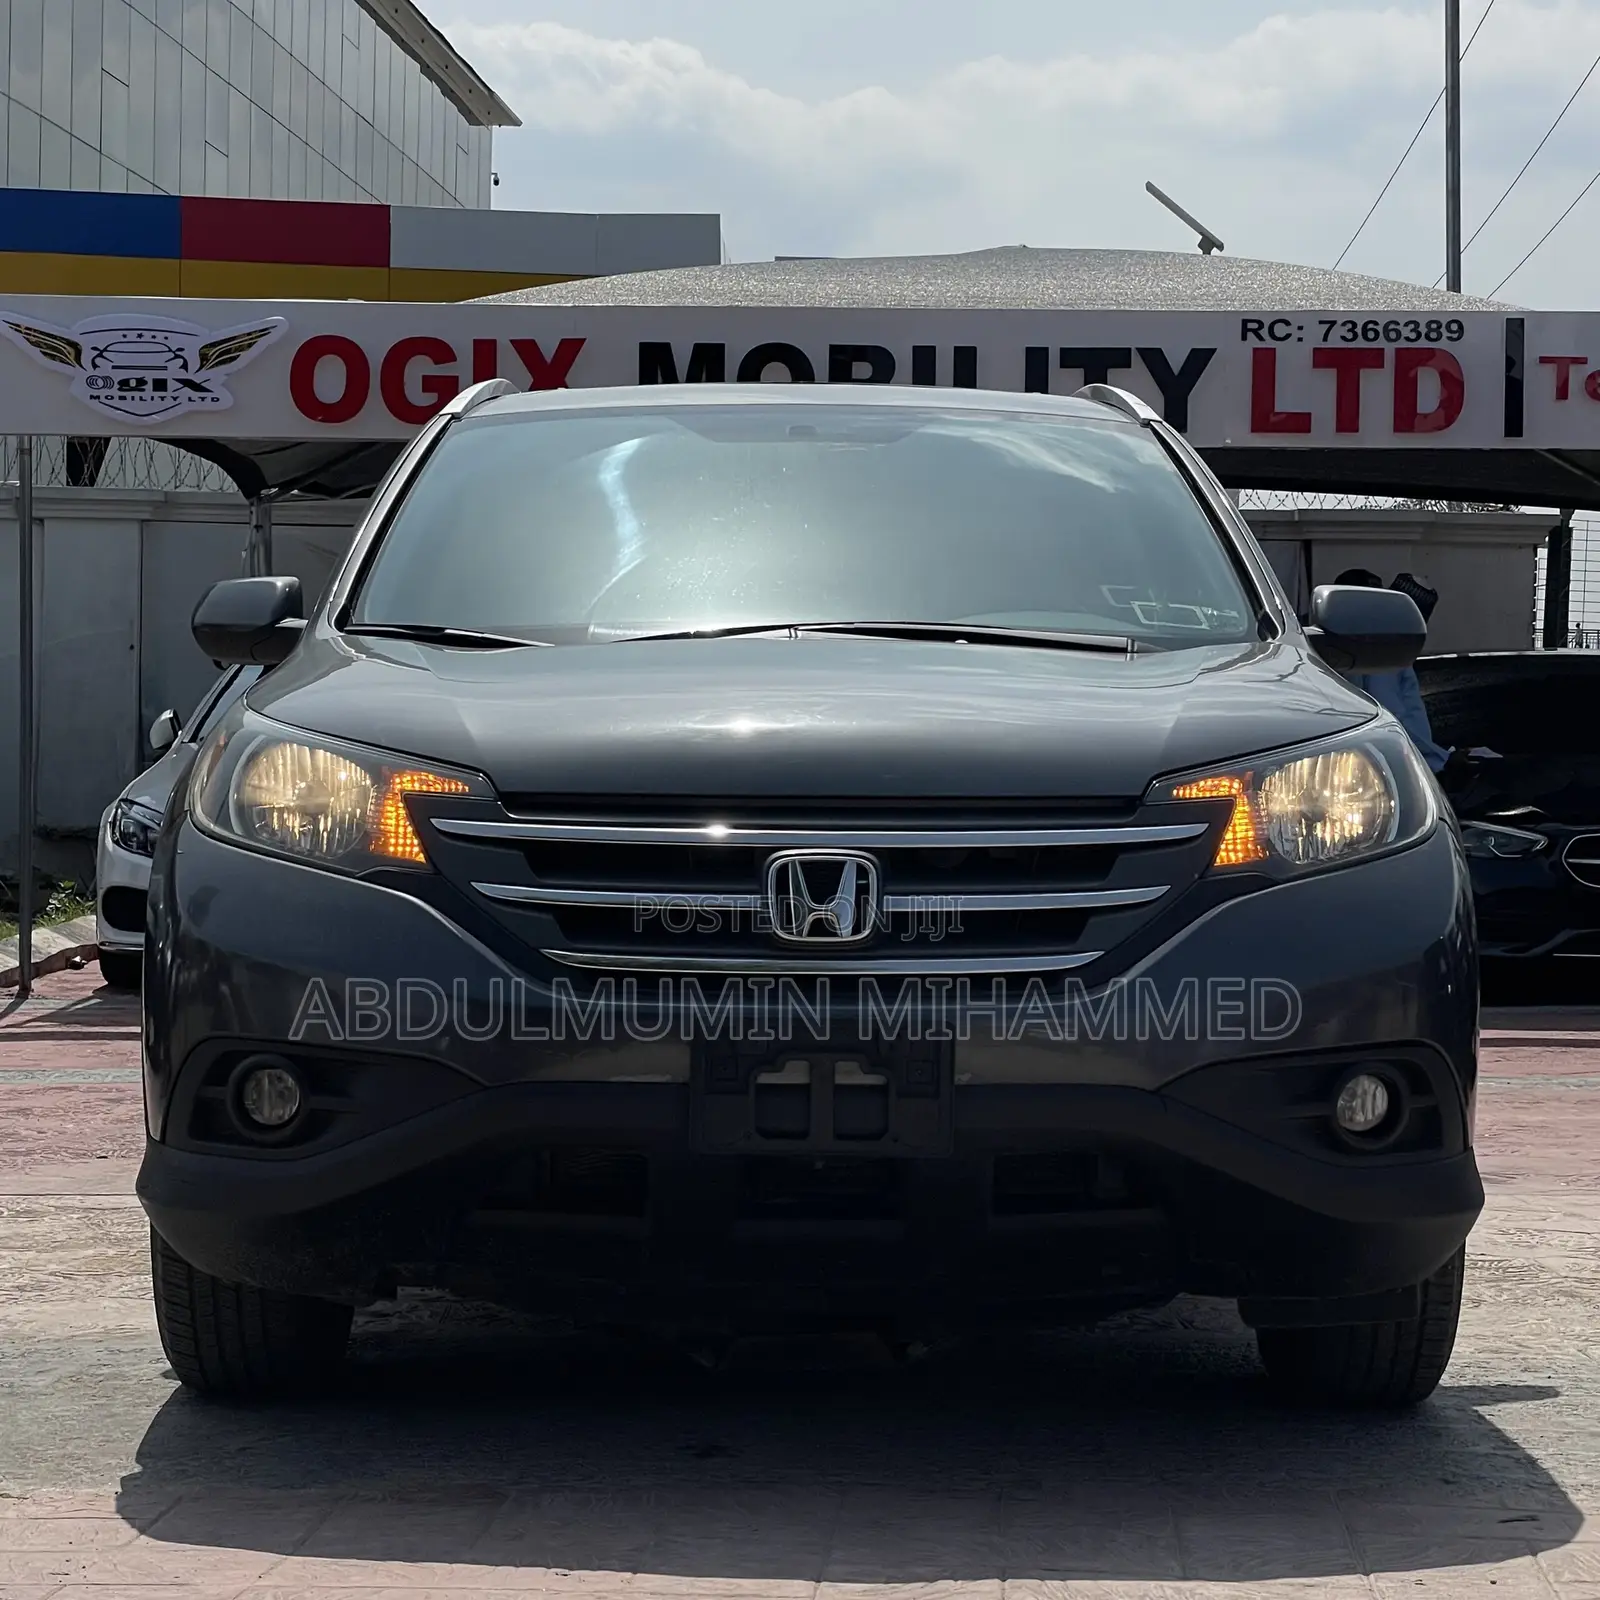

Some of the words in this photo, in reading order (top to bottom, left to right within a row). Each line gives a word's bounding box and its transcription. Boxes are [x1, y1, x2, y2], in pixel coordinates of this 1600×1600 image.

[1240, 318, 1304, 342] RC:
[1318, 319, 1465, 343] 7366389
[289, 334, 587, 425] OGIX
[1250, 346, 1465, 434] LTD
[89, 394, 180, 402] MOBILITY
